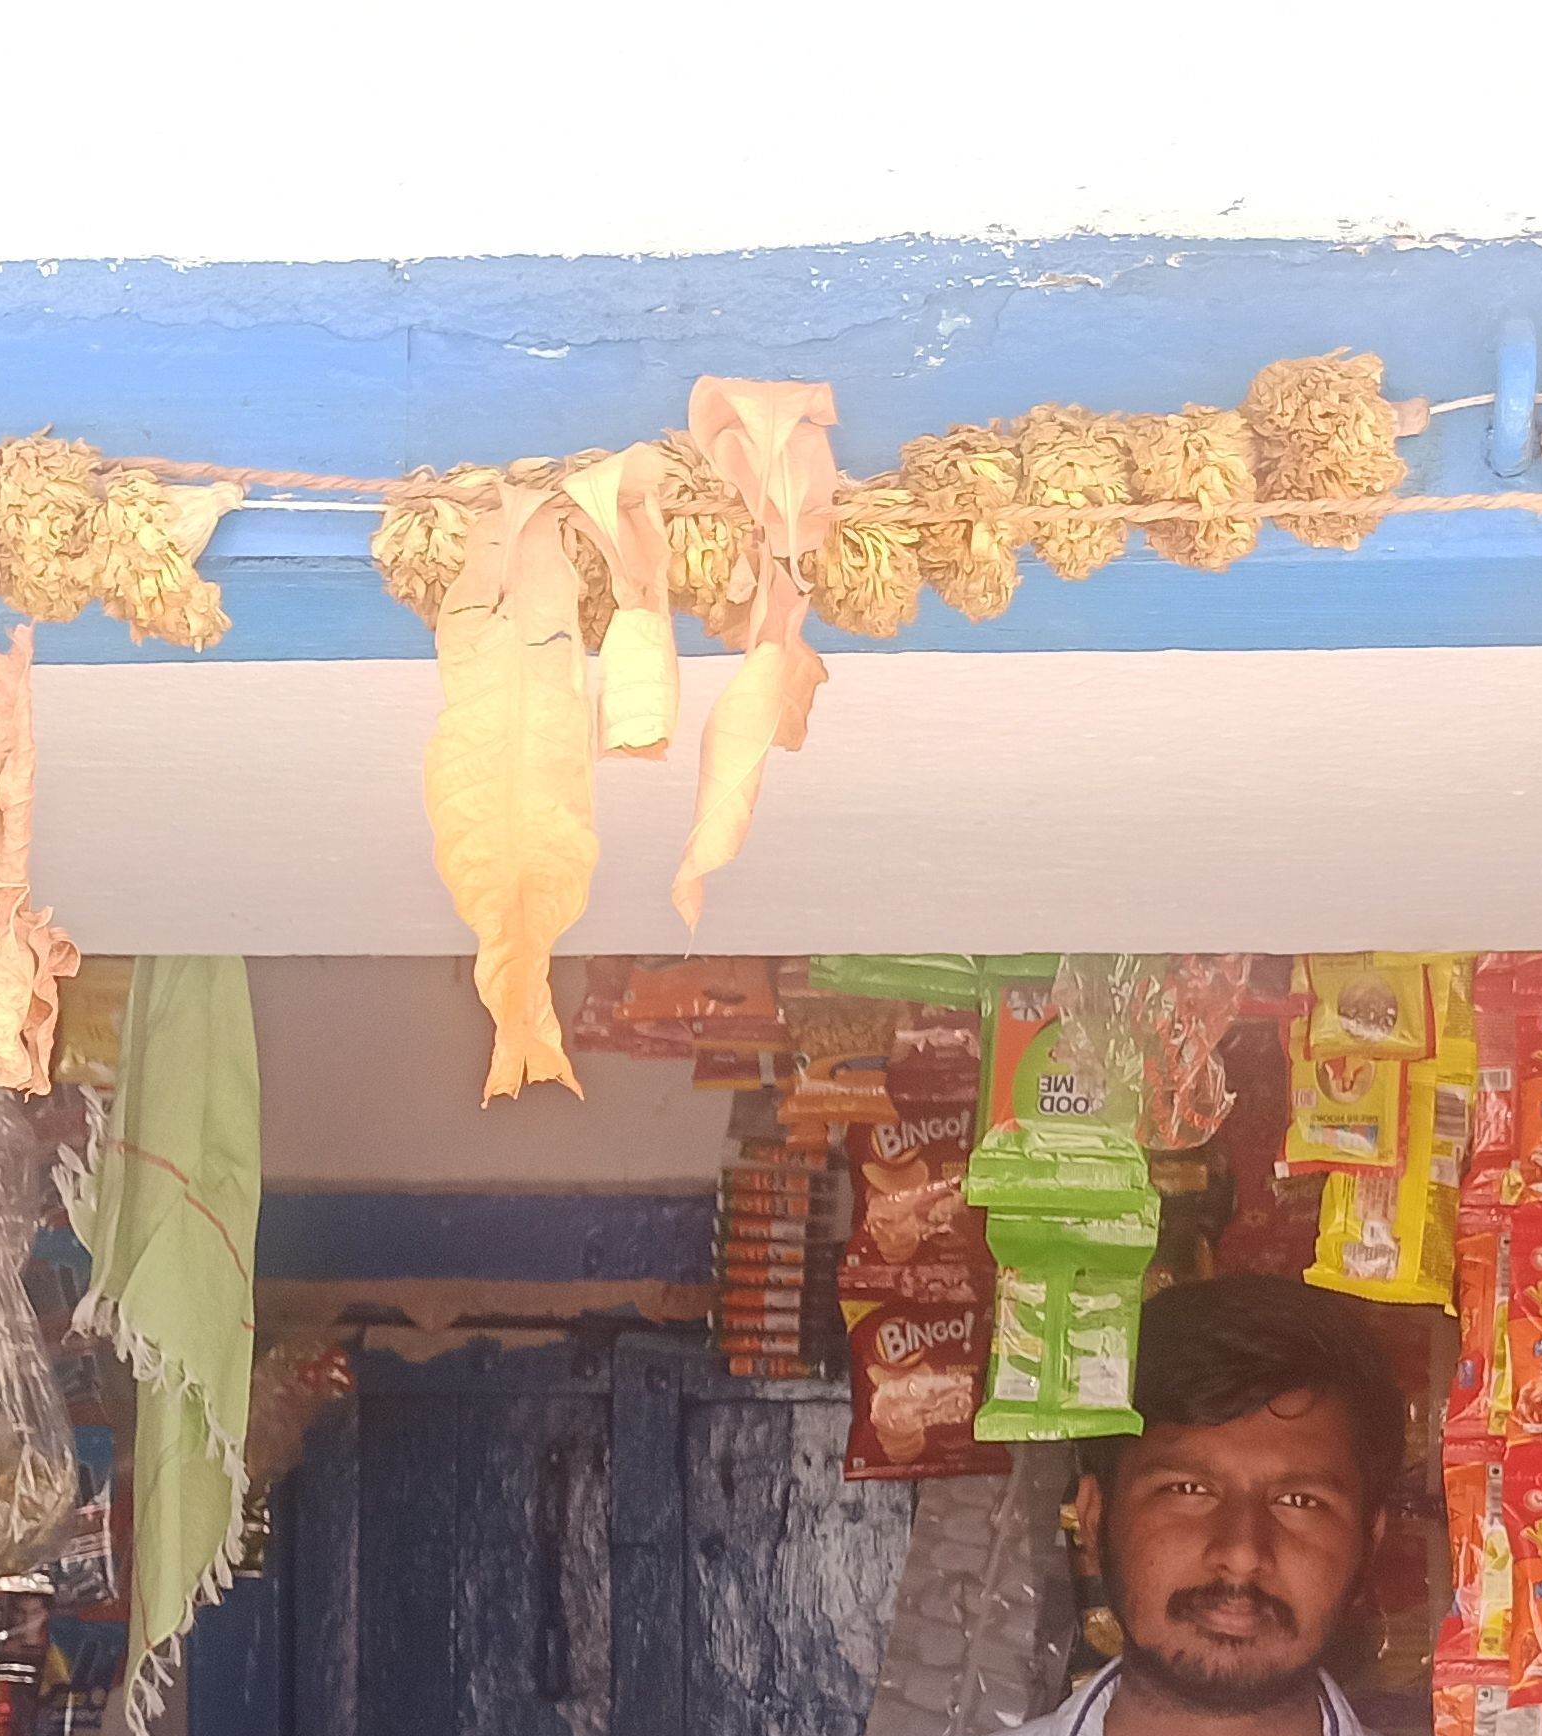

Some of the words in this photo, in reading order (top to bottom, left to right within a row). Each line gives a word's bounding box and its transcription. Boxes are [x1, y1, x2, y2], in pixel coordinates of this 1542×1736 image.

[1040, 1075, 1075, 1094] ME
[1039, 1096, 1093, 1114] OOD
[875, 1109, 971, 1159] BINGO!
[879, 1311, 976, 1363] BINGO!
